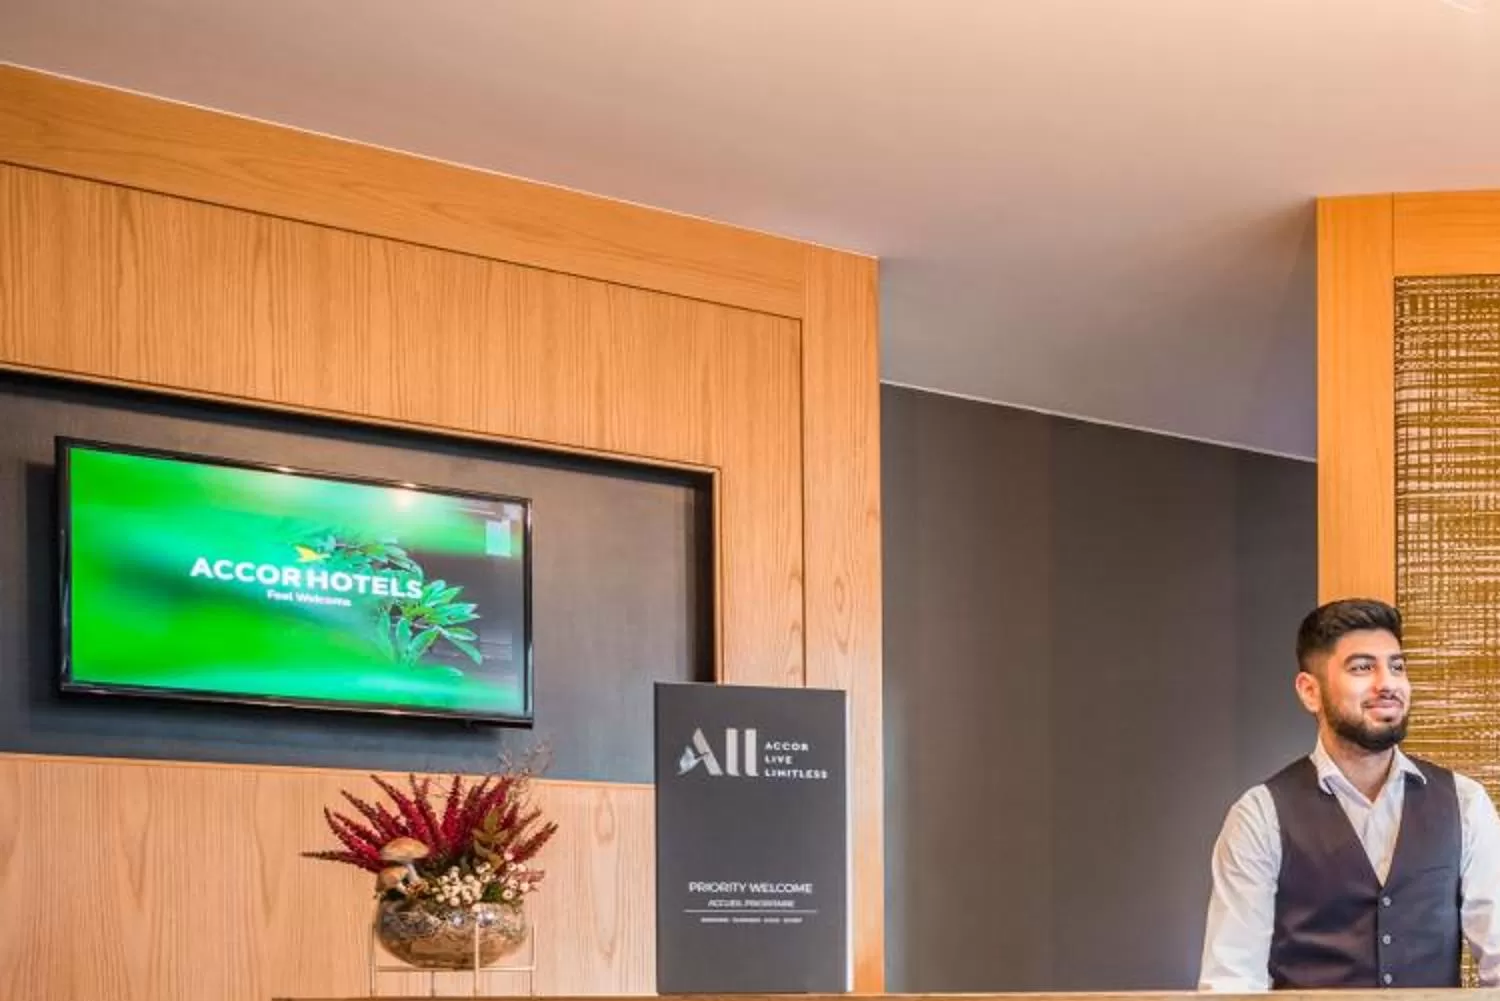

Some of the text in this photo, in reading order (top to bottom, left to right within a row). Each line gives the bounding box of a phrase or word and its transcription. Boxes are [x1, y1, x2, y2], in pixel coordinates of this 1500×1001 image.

[190, 556, 423, 600] ACCOR HOTELS
[764, 741, 809, 752] ACCOR
[764, 754, 793, 765] LIVE
[764, 768, 828, 780] LIMITLESS
[689, 882, 813, 894] PRIORITY WELCOME
